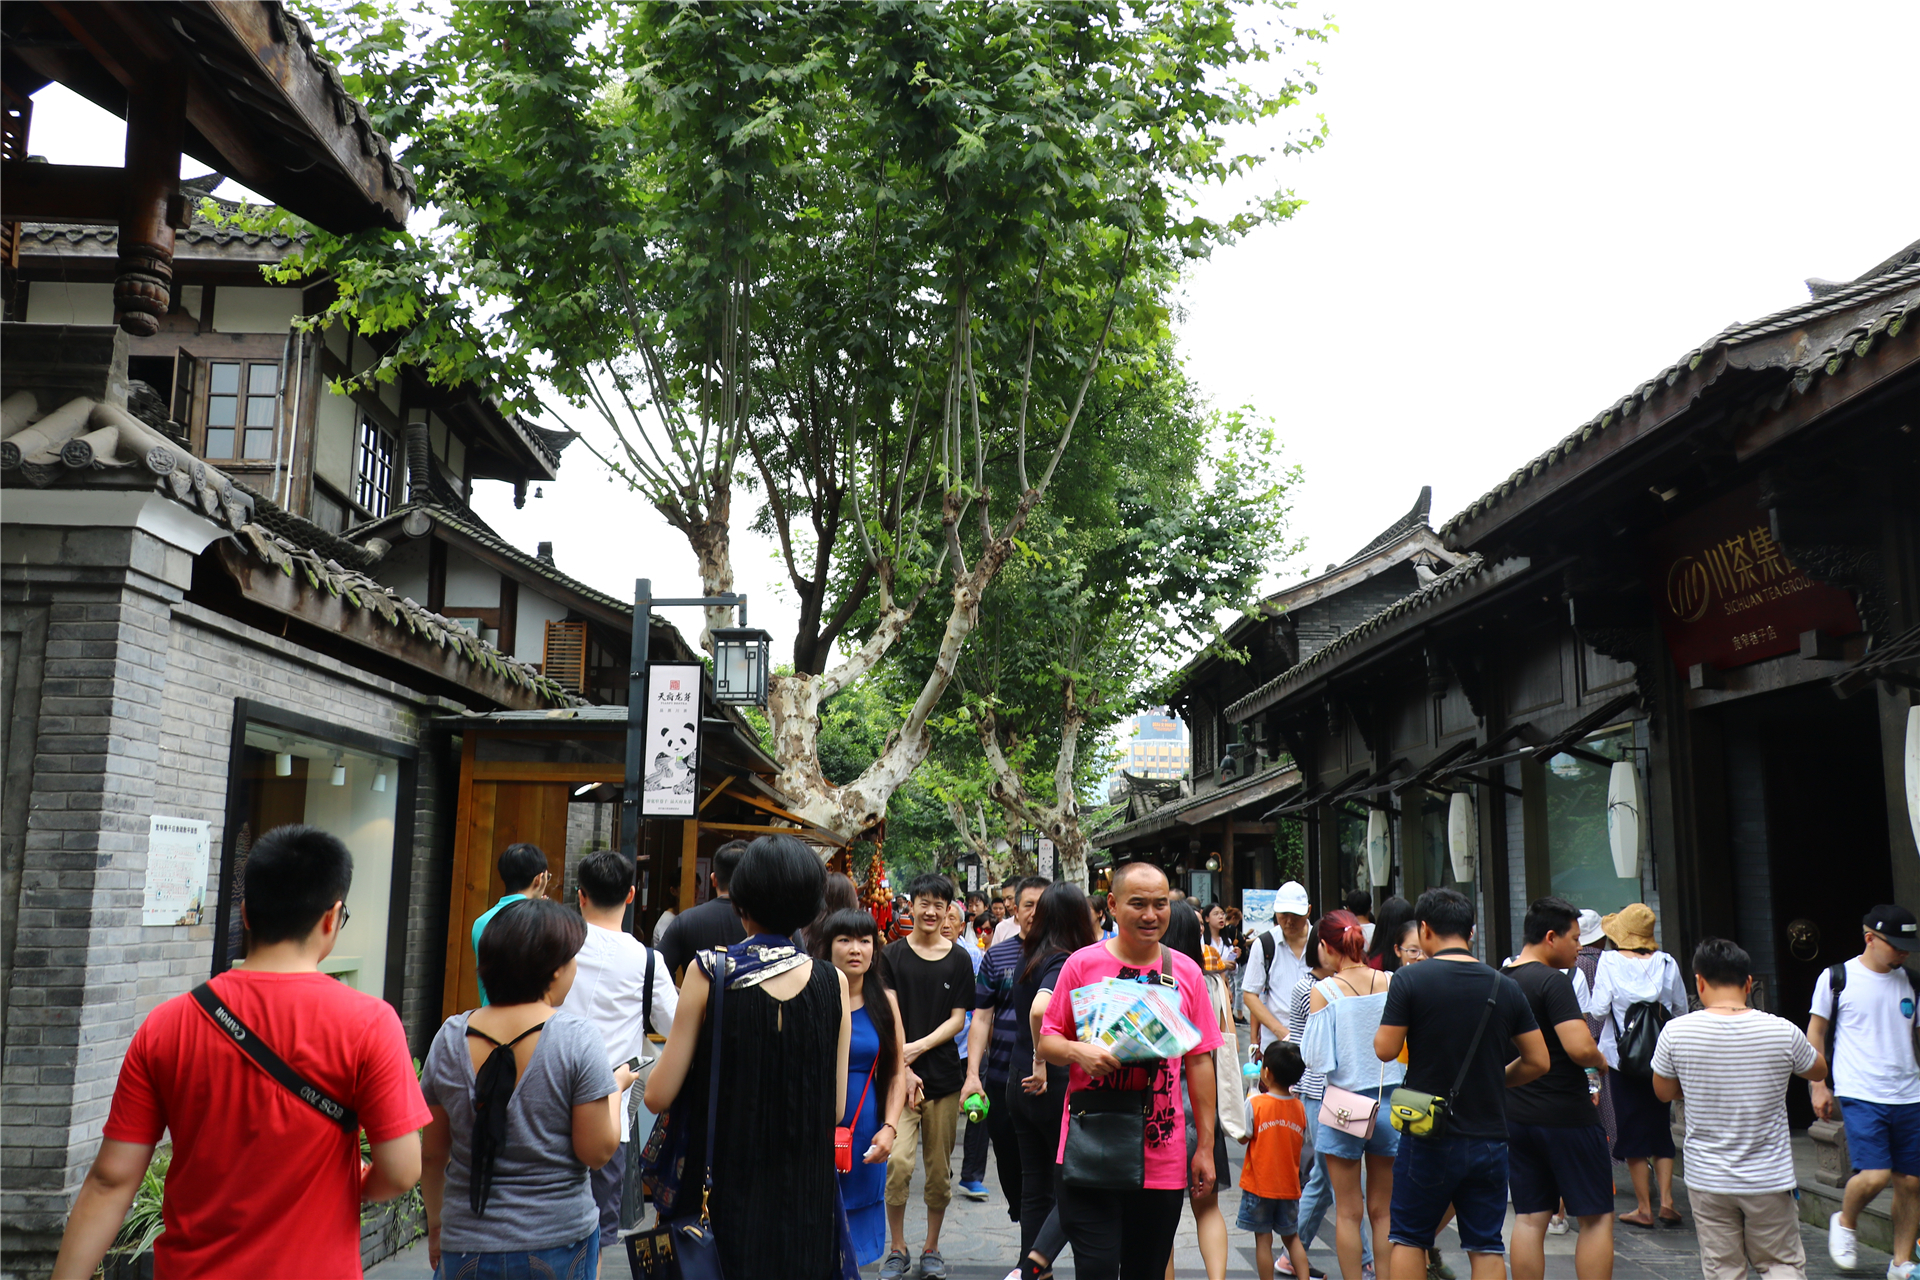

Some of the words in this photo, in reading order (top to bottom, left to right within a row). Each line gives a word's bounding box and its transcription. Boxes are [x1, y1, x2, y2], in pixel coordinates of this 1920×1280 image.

[1723, 590, 1763, 616] SICHUAN
[1761, 584, 1782, 602] TEA
[1731, 625, 1778, 651] 宽窄巷子店
[214, 1006, 247, 1041] Canon
[300, 1085, 321, 1106] 70D
[318, 1098, 344, 1120] EOS
